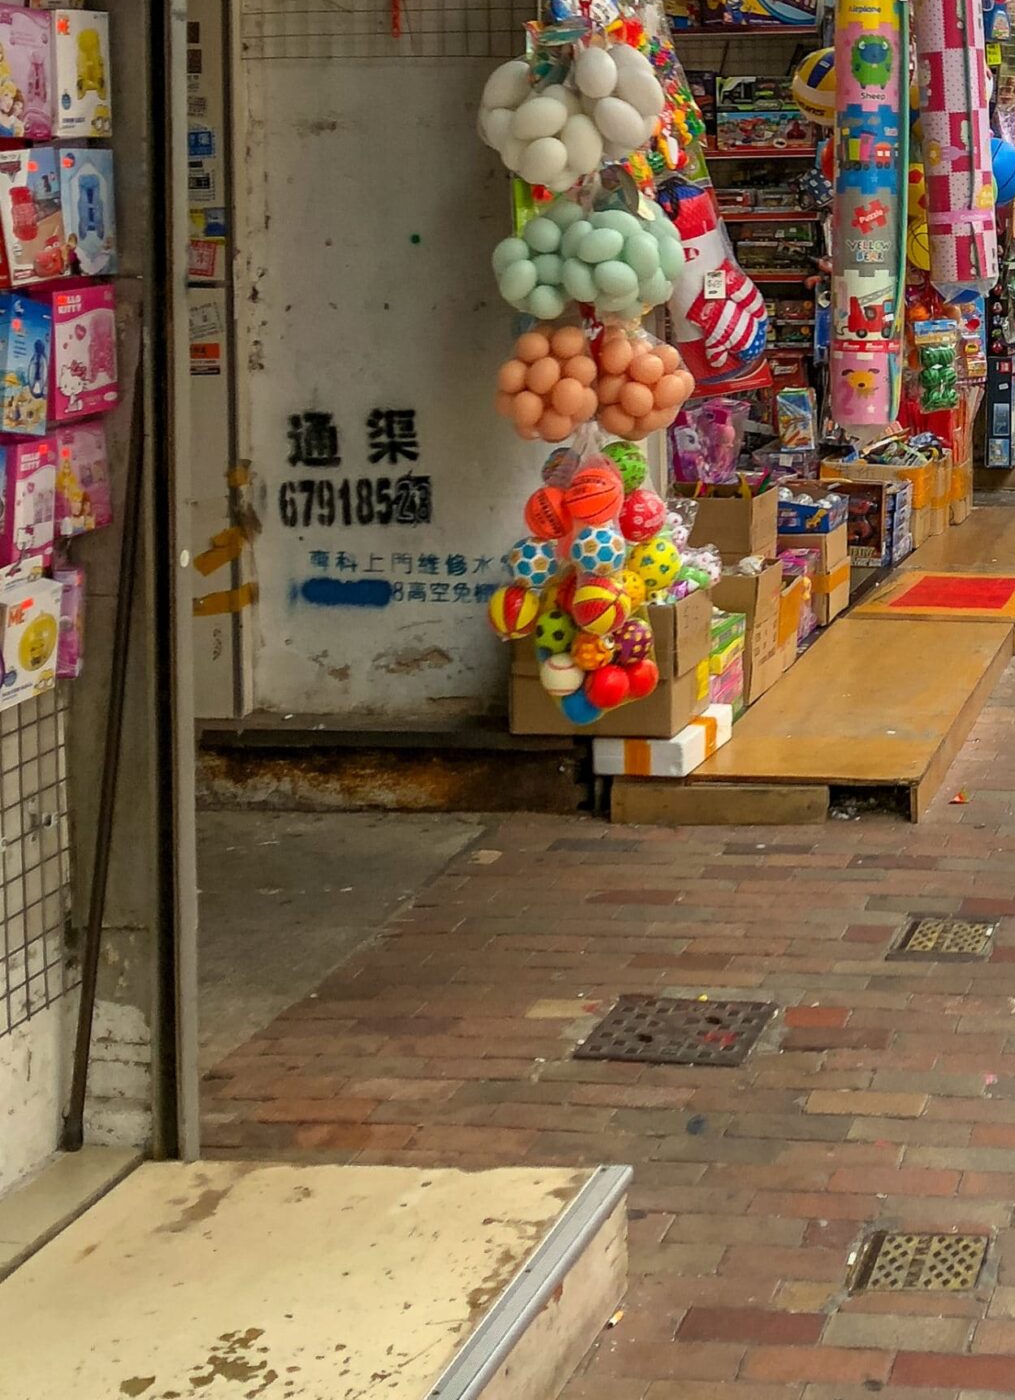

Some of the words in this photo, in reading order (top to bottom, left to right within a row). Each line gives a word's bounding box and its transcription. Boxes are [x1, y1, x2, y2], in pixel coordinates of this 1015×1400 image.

[860, 91, 886, 101] Sheep
[859, 209, 885, 224] Puzzle
[287, 407, 420, 468] 通渠
